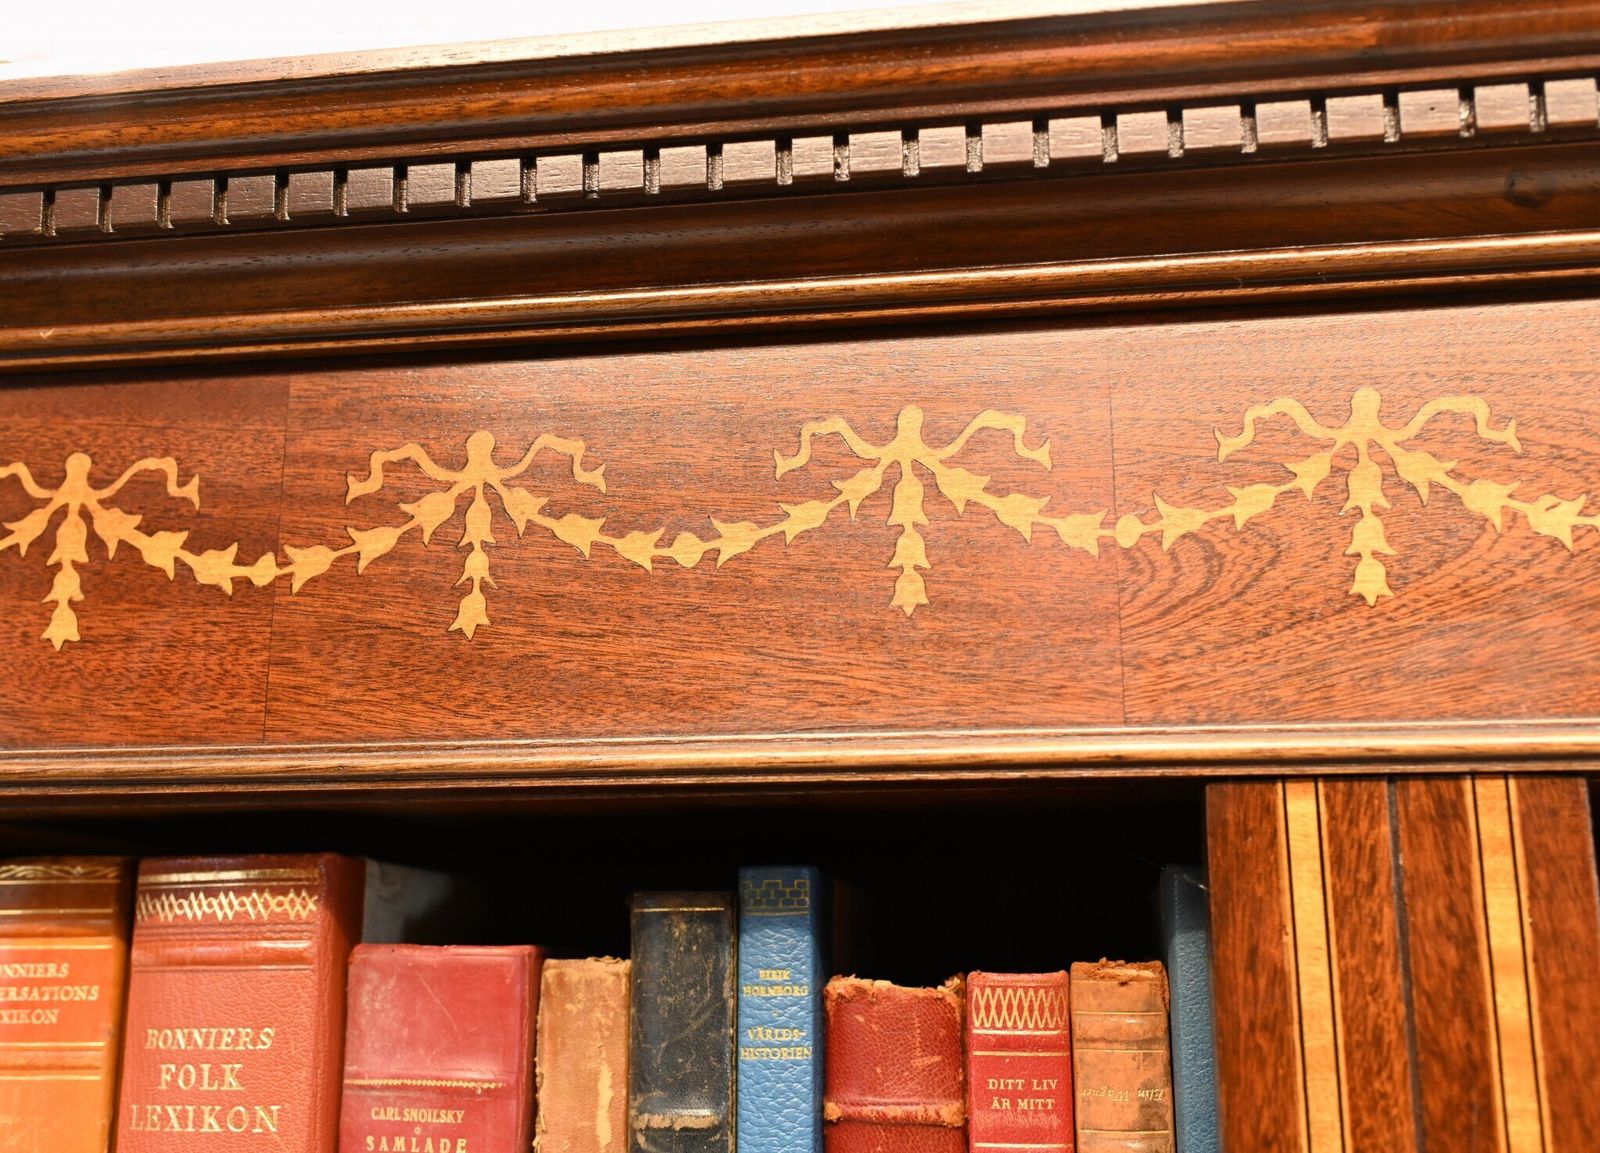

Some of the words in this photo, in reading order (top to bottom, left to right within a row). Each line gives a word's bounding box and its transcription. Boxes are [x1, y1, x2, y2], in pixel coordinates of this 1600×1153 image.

[0, 963, 69, 978] NNIERS
[742, 984, 809, 996] HORNBORG
[145, 1027, 276, 1050] BONNIERS
[747, 1026, 807, 1041] VÄRLDS-
[740, 1045, 813, 1060] HISTORIEN
[158, 1063, 245, 1090] FOLK
[987, 1078, 1025, 1091] DITT
[1031, 1079, 1058, 1091] LIV
[1136, 1087, 1166, 1101] Elin
[991, 1096, 1011, 1110] ÄR
[1017, 1098, 1055, 1110] MITT
[129, 1103, 281, 1133] LEXIKON
[371, 1106, 401, 1121] CARL
[402, 1107, 465, 1123] SNOILSKY
[365, 1135, 467, 1153] SAMLADE
